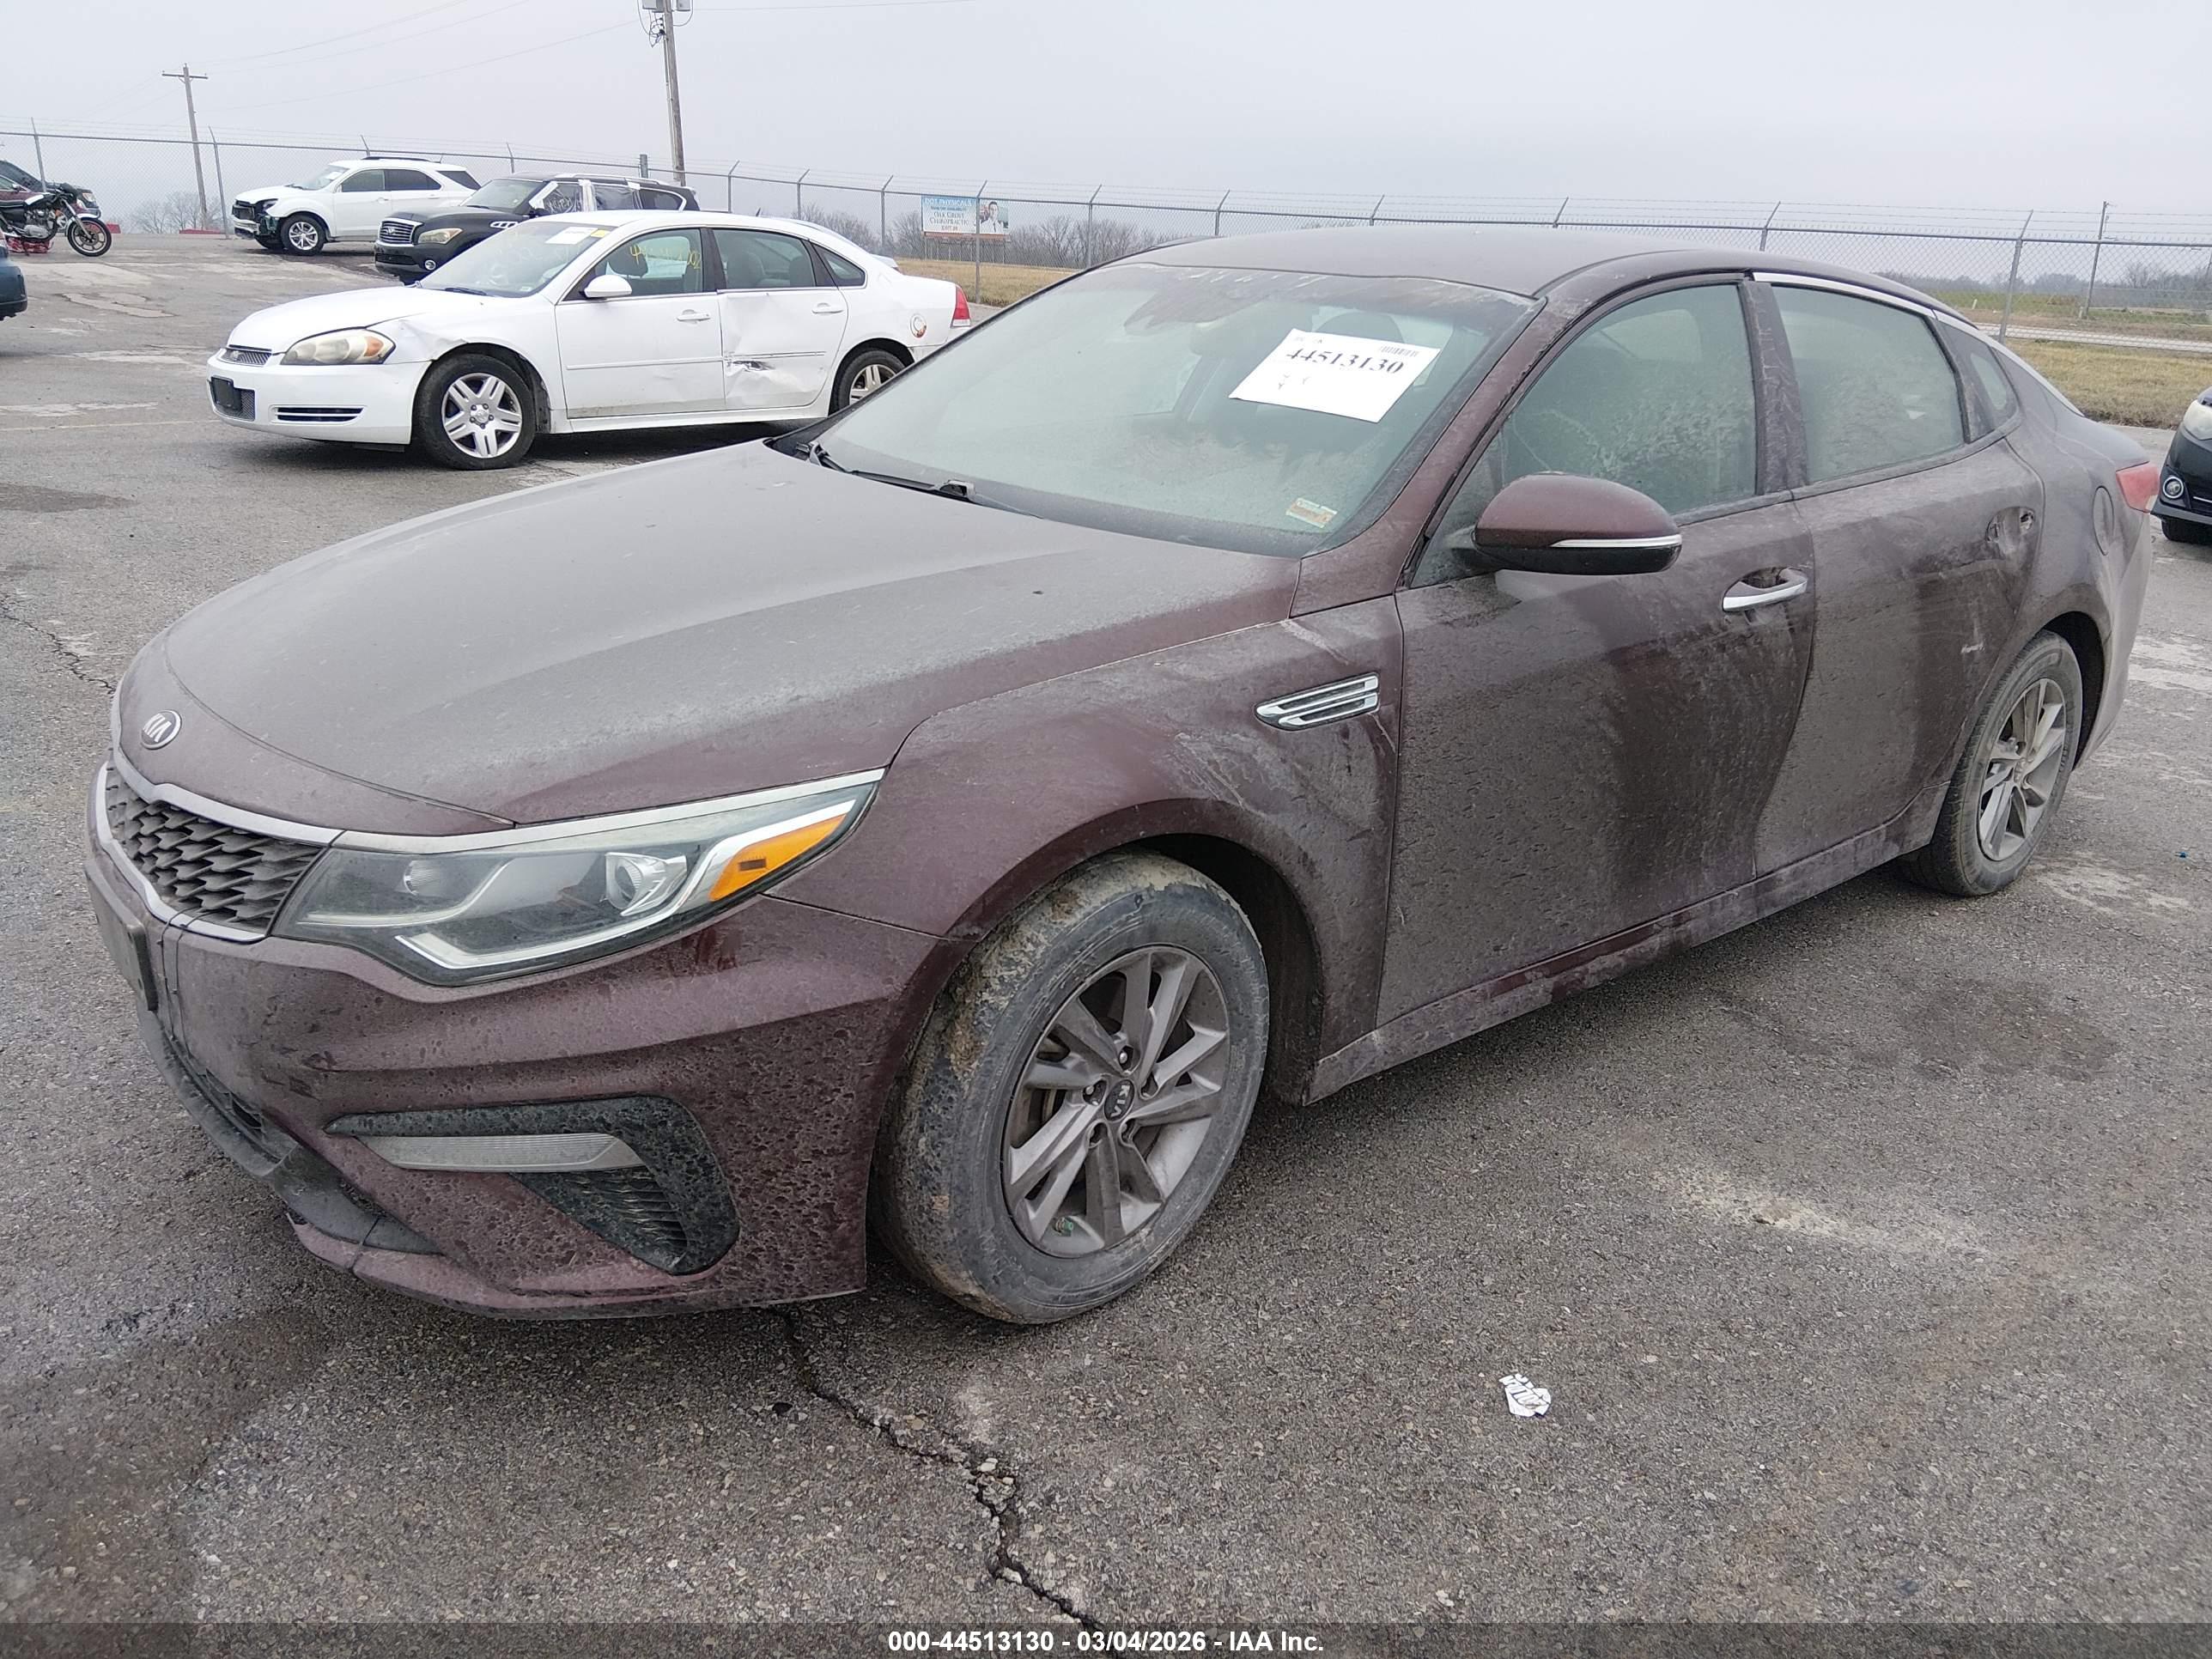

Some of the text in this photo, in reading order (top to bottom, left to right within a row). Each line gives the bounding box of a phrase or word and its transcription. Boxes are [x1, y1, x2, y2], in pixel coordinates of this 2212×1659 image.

[1286, 348, 1404, 374] 44513130
[143, 713, 173, 743] KIA
[1110, 1085, 1131, 1117] KIA
